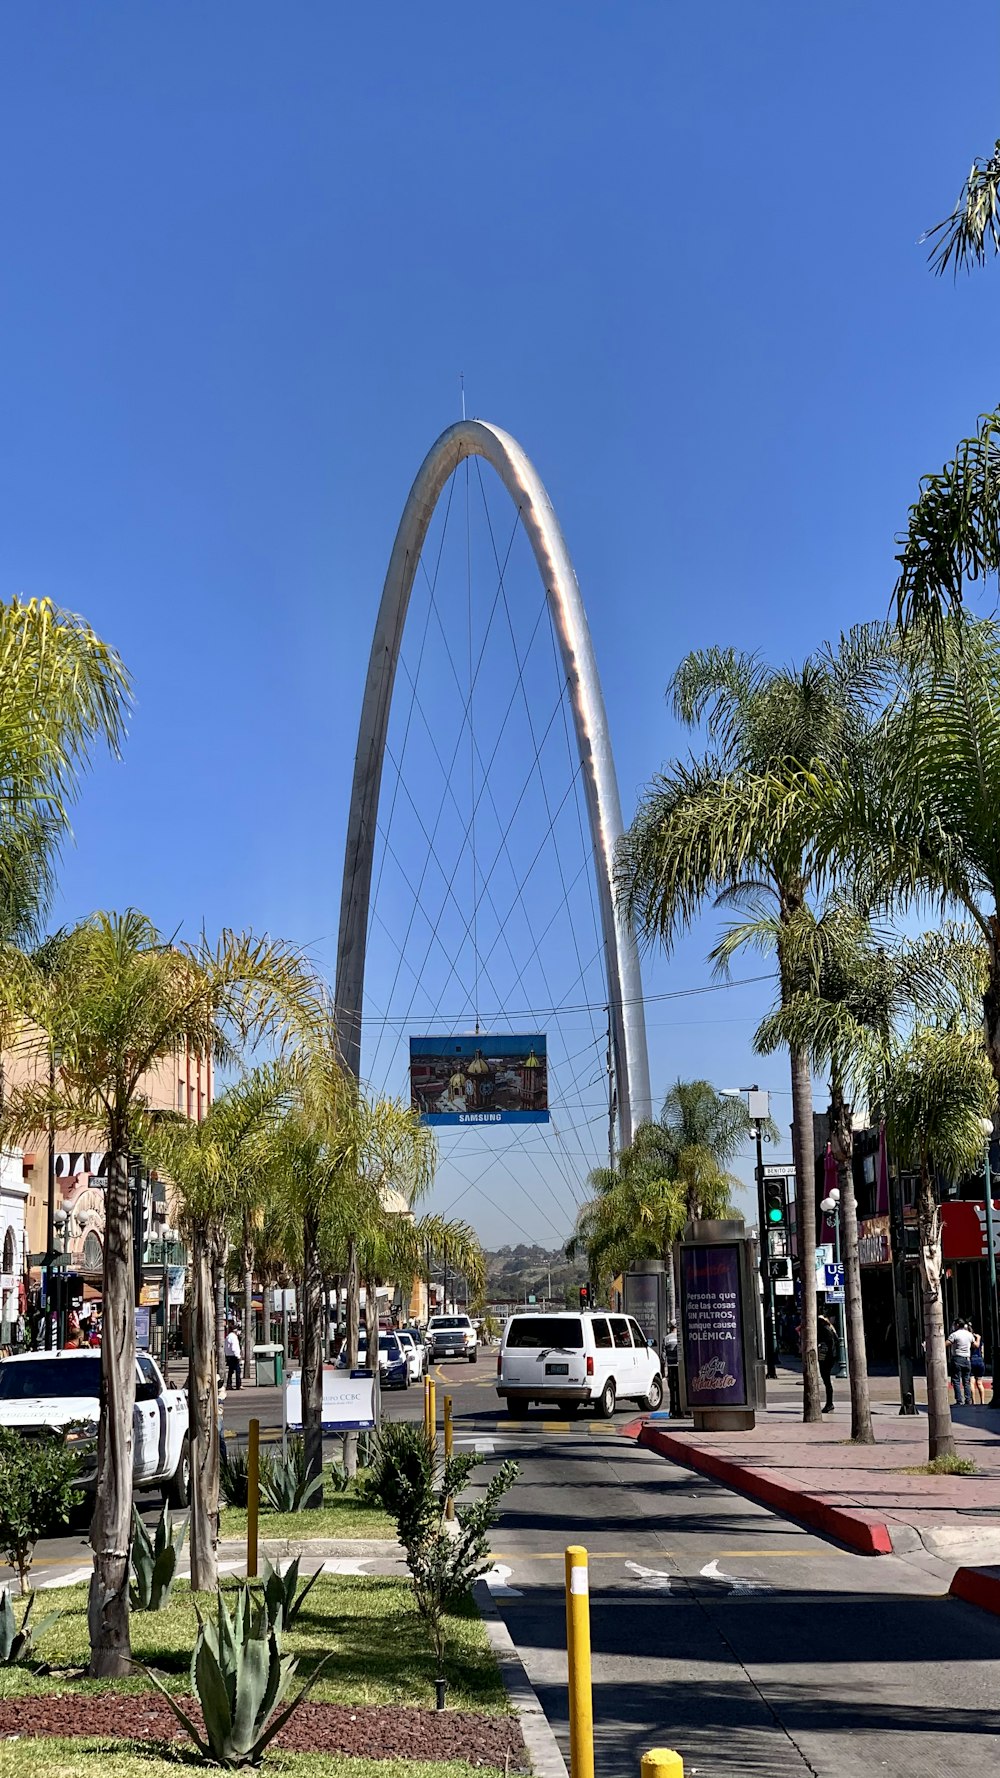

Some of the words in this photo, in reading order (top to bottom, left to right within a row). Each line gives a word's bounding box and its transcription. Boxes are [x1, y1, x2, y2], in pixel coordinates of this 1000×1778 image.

[459, 1114, 502, 1122] SAMSUNG
[719, 1292, 736, 1301] que
[699, 1312, 736, 1320] FILTROS,
[688, 1331, 736, 1340] POLÉMICA.
